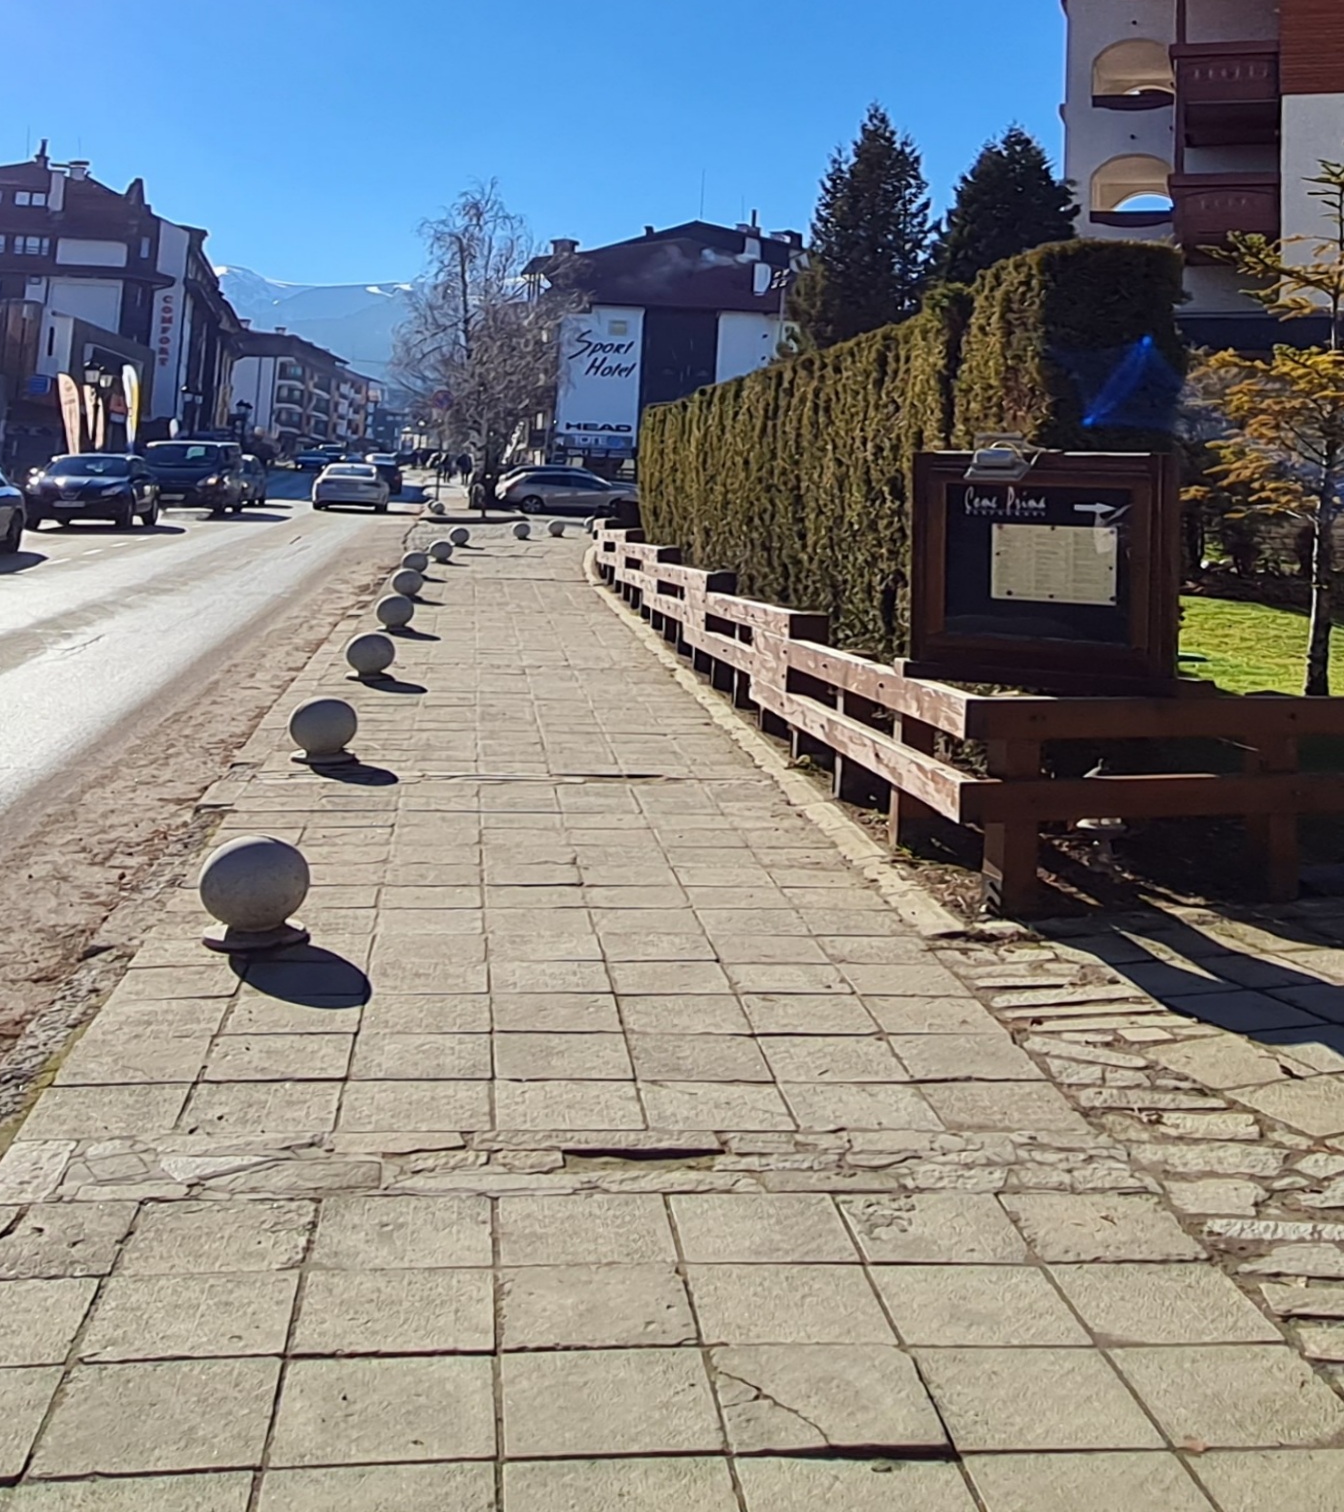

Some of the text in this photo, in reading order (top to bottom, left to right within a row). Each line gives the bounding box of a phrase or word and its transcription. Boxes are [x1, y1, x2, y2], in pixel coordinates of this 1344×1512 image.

[159, 294, 174, 367] COMFORT
[567, 329, 635, 360] Sport
[584, 356, 637, 378] Hotel
[565, 422, 632, 433] HEAD
